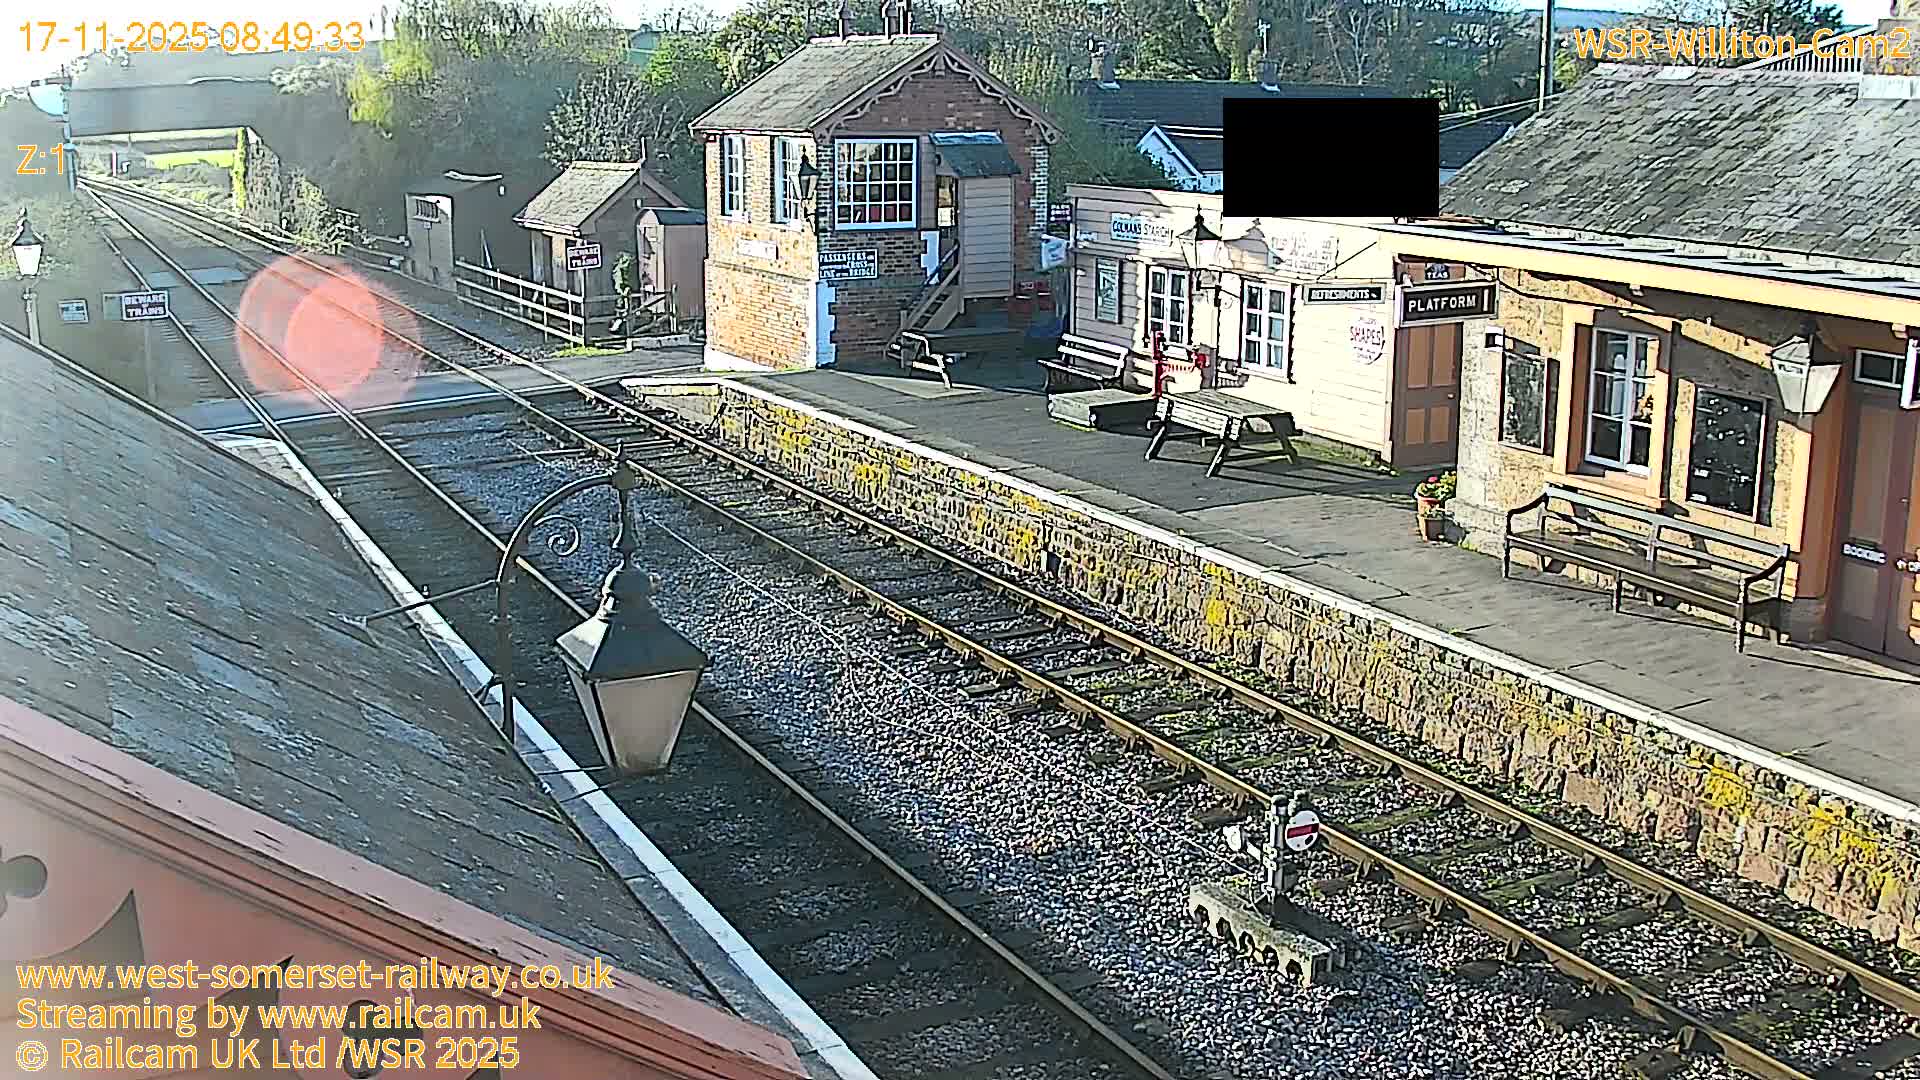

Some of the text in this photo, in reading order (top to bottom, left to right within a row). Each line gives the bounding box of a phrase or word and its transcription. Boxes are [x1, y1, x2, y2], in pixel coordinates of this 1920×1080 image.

[819, 252, 867, 262] PASSENGERS
[846, 260, 868, 269] CROSS
[849, 267, 875, 276] BRIDGE
[1426, 271, 1449, 279] TEAS
[124, 294, 166, 305] BEWARE
[1311, 289, 1370, 300] REFRESHMENTS
[1408, 295, 1477, 313] PLATFORM
[127, 306, 164, 317] TRAINS
[1350, 326, 1381, 345] SHAPES
[1843, 543, 1886, 564] BOOKING
